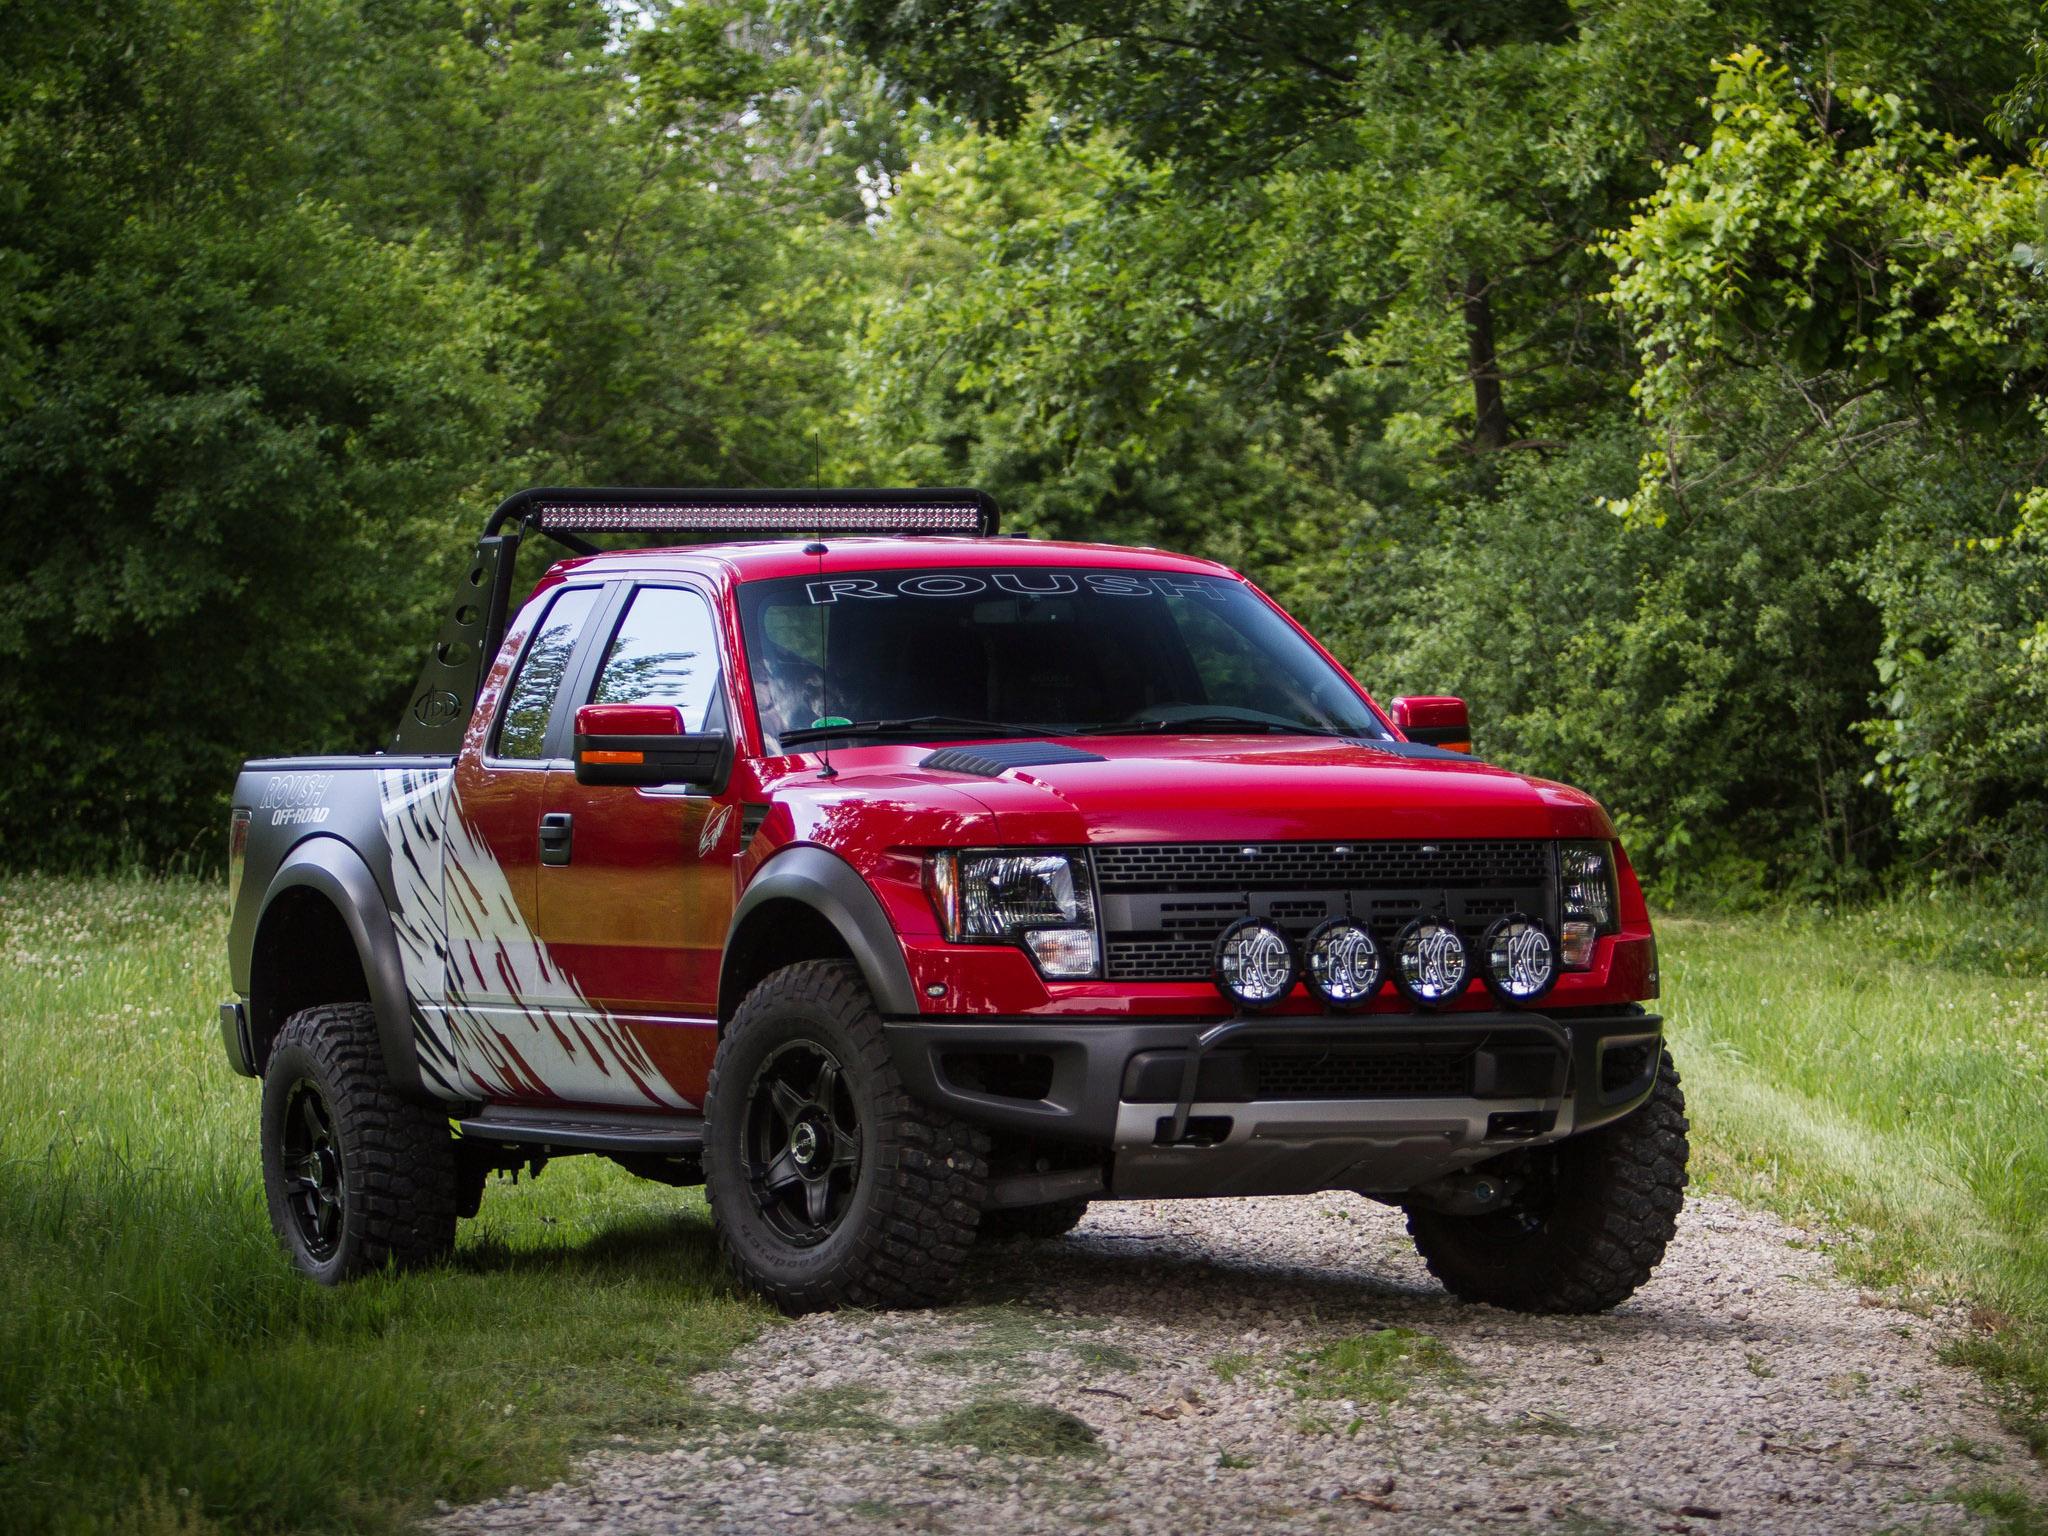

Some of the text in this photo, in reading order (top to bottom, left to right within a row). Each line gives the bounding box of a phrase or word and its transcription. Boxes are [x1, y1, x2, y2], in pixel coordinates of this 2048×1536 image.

[806, 574, 1227, 605] ROUSH
[259, 774, 334, 809] ROUSH
[271, 807, 330, 825] OFF-ROAD
[1238, 932, 1286, 991] KC
[1328, 932, 1374, 992] KC
[1418, 932, 1462, 990] KC
[1508, 929, 1550, 988] KC
